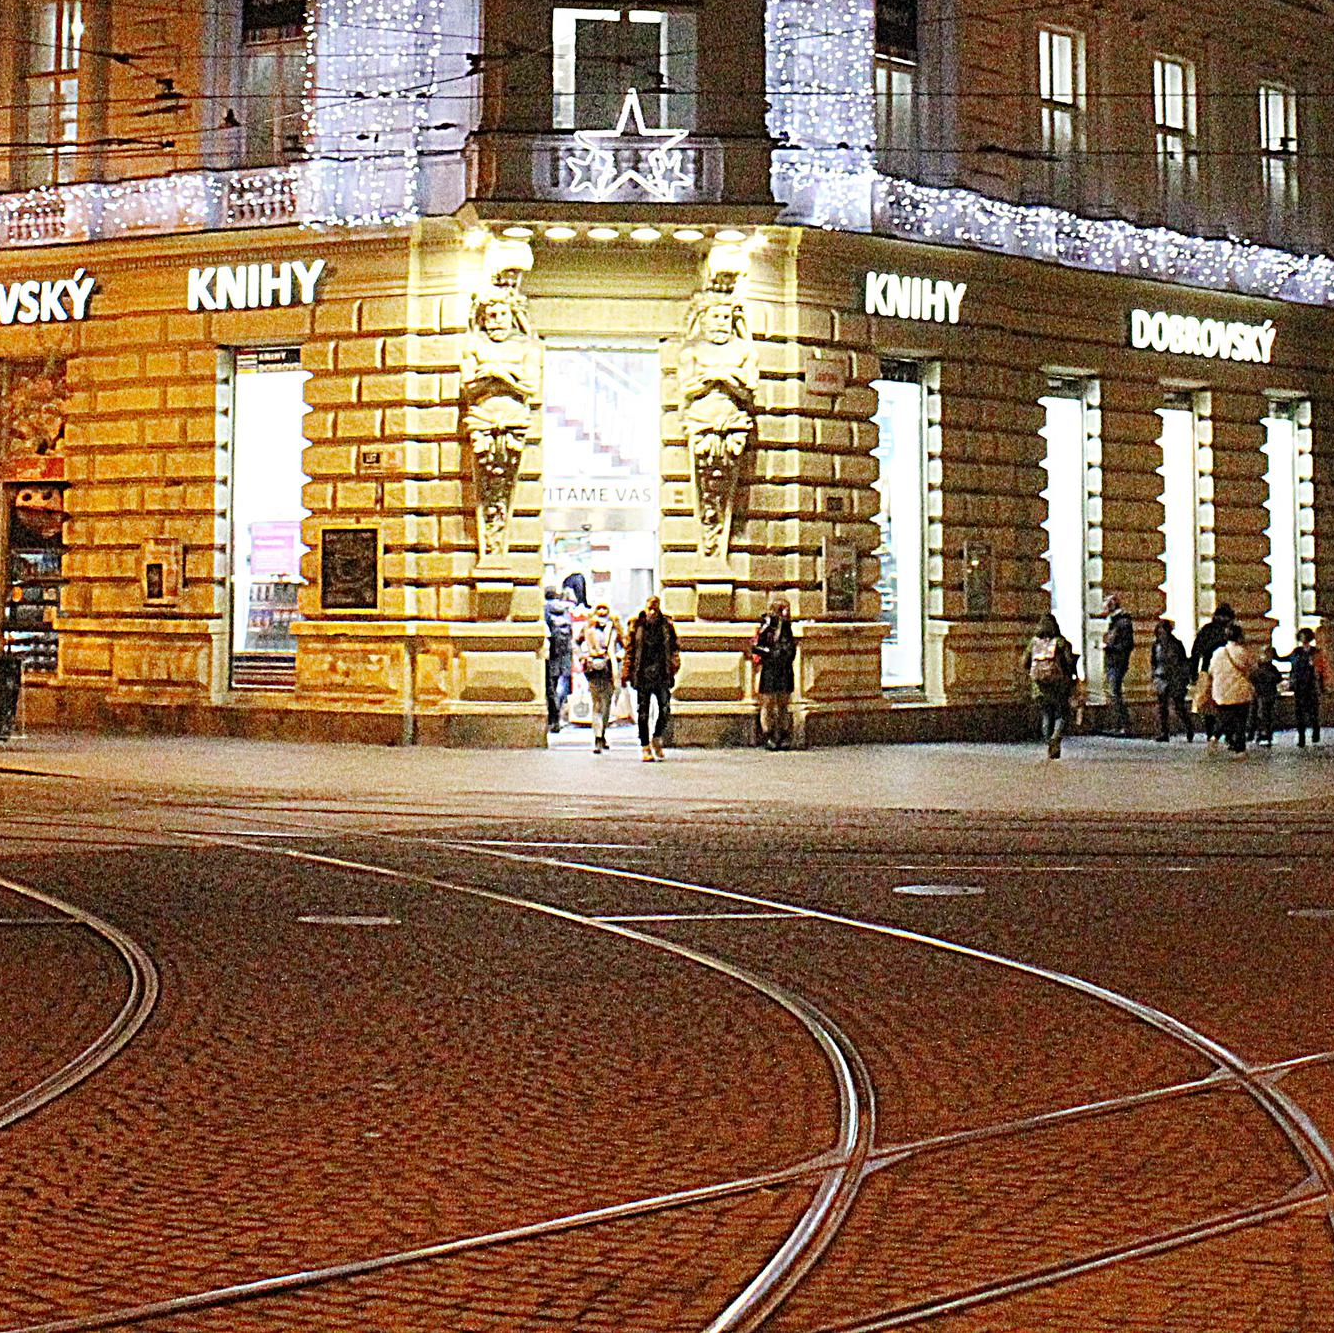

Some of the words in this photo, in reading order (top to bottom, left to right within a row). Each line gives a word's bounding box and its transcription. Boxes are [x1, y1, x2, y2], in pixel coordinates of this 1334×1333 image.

[187, 258, 327, 312] KNIHY
[865, 270, 967, 325] KNIHY
[1130, 308, 1278, 365] DOBROVSKÝ
